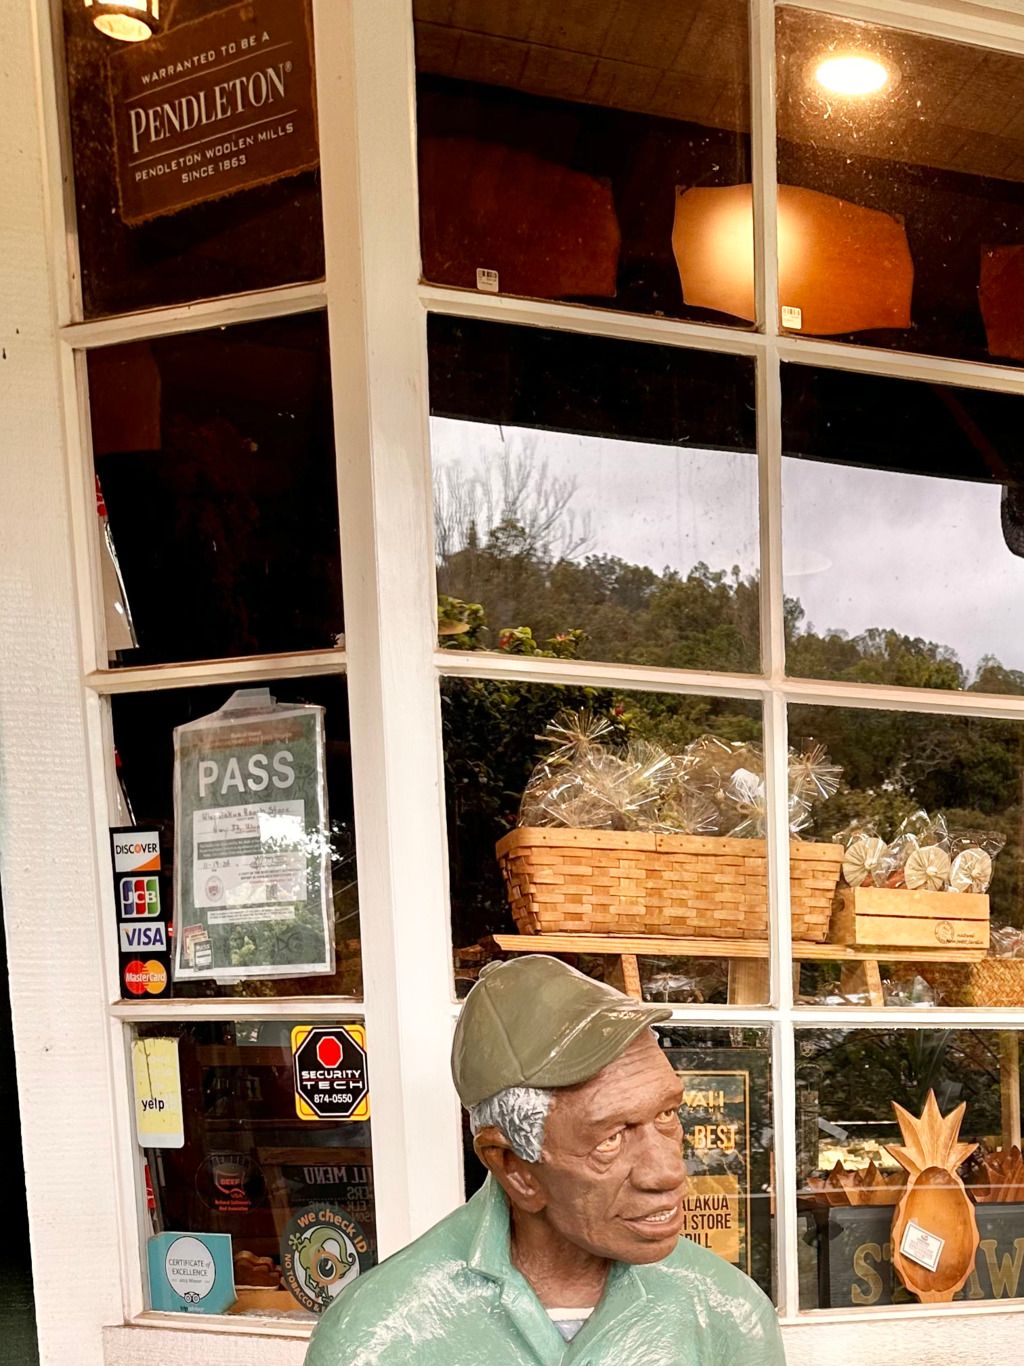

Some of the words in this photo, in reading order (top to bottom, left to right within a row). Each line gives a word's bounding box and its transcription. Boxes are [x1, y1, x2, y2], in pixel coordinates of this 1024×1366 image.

[141, 50, 216, 85] WARRANTED
[221, 42, 236, 57] TO
[241, 35, 257, 49] BE
[262, 31, 270, 42] A
[135, 152, 201, 182] PENDLETON
[205, 135, 254, 159] WOOLEN
[258, 122, 294, 142] MILLS
[181, 164, 215, 184] SINCE
[219, 154, 247, 172] 1863
[199, 751, 295, 797] PASS
[115, 843, 158, 855] DISCOVER
[124, 890, 157, 906] JCB
[124, 927, 164, 946] VISA
[125, 972, 167, 983] MasterCard
[301, 1070, 361, 1079] SECURITY
[303, 1081, 363, 1089] TECH
[142, 1098, 165, 1111] yelp
[314, 1094, 352, 1104] 874-0550
[694, 1125, 738, 1150] BEST
[692, 1213, 731, 1230] STORE
[319, 1209, 356, 1236] check
[354, 1235, 368, 1253] ID
[168, 1259, 204, 1268] CERTIFICATE
[284, 1253, 291, 1269] NO
[172, 1268, 208, 1276] EXCELLENCE
[287, 1270, 313, 1308] TOBACCO
